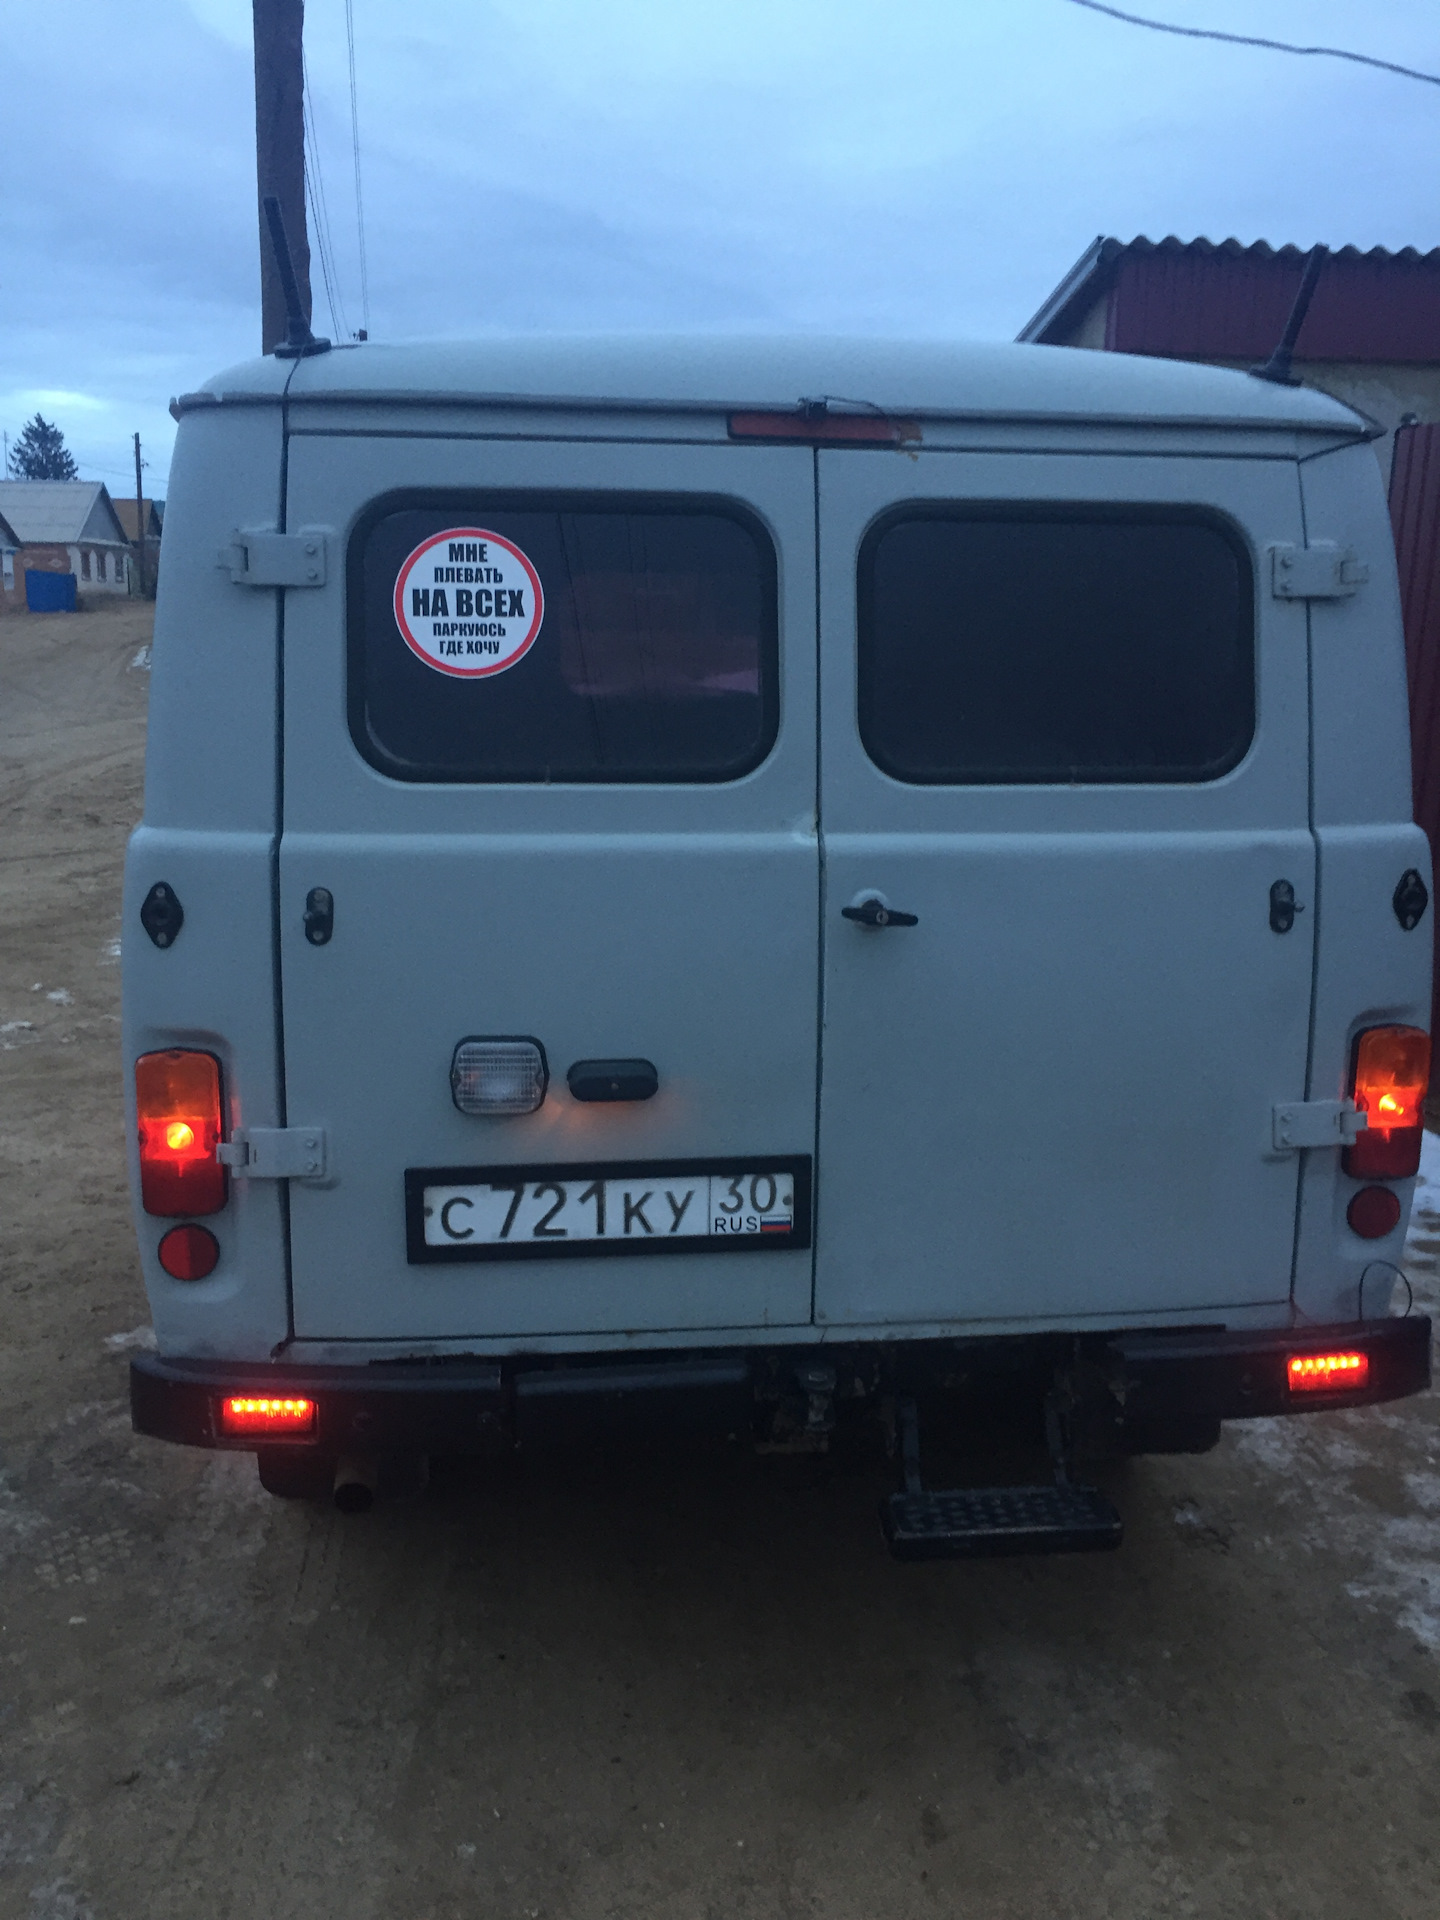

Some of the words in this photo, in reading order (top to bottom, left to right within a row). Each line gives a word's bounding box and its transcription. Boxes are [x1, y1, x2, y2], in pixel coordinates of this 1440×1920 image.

[448, 543, 488, 562] МНЕ
[434, 567, 504, 583] ПЛЕВАТЬ
[412, 588, 449, 617] НА
[456, 588, 525, 617] ВСЕХ
[433, 623, 506, 637] ПАРКУЮСЬ
[440, 641, 463, 656] ГДЕ
[466, 640, 500, 655] ХОЧУ
[718, 1174, 778, 1214] 30
[714, 1215, 758, 1233] RUS
